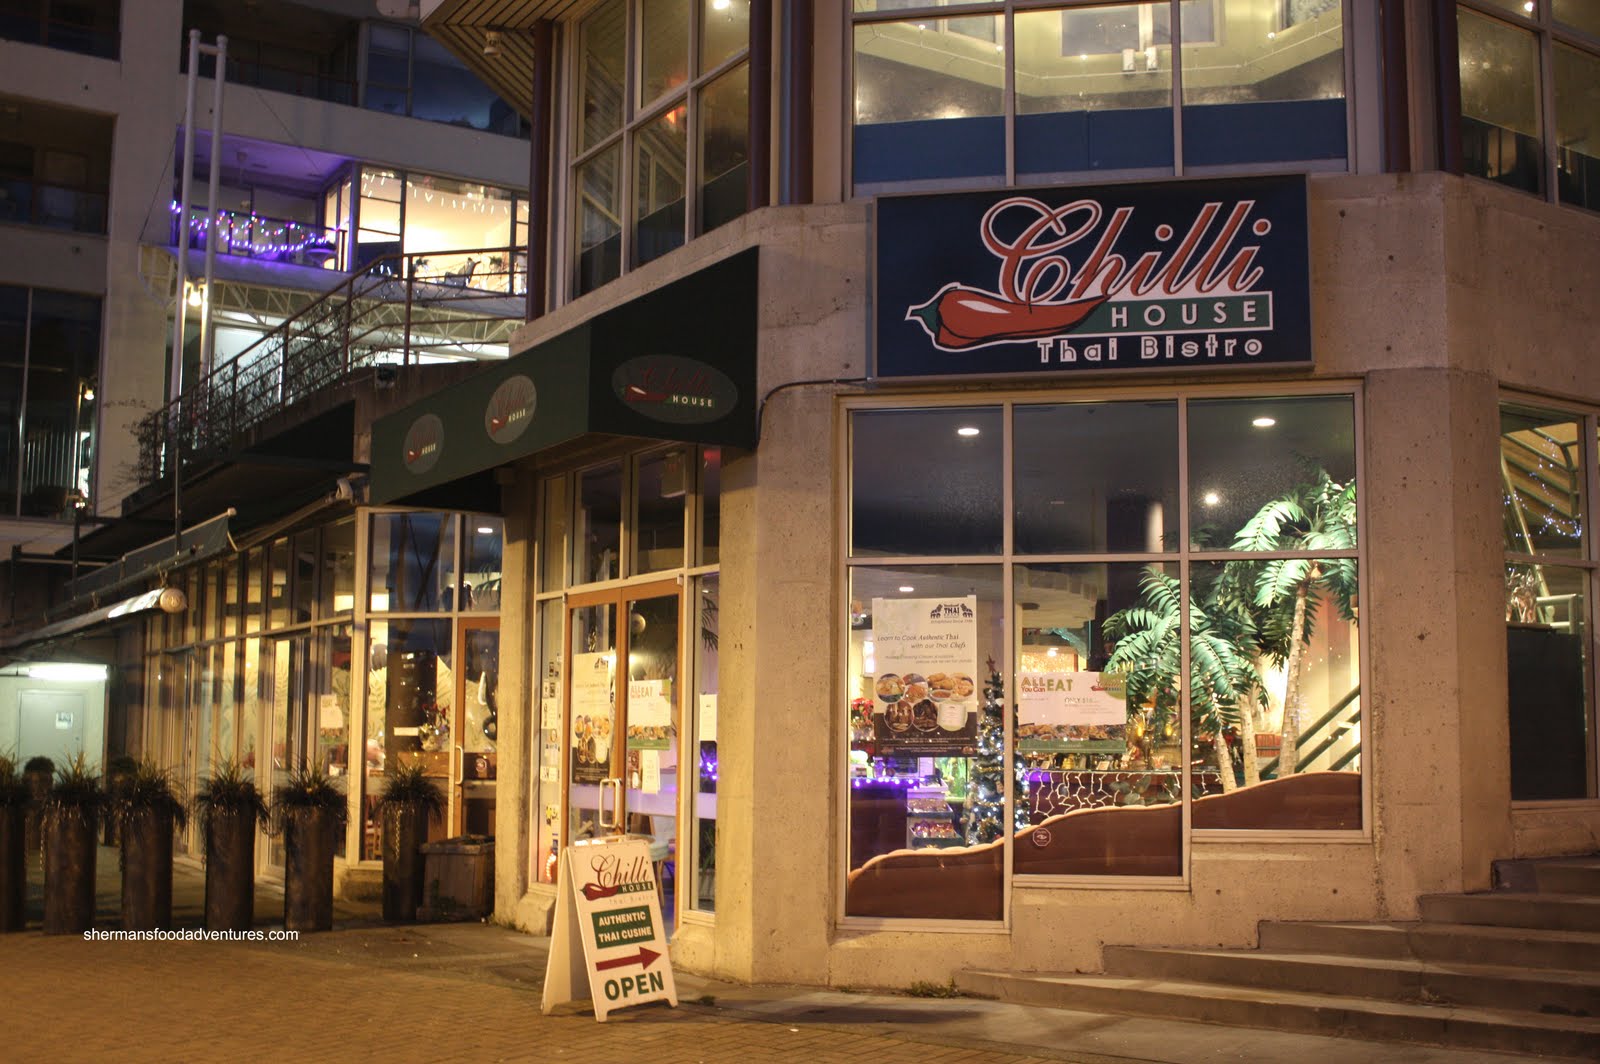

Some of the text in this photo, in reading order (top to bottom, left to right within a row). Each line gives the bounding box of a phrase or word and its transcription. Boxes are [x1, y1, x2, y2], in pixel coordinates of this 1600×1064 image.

[980, 197, 1272, 303] Chilli
[1111, 300, 1256, 328] HOUSE
[1037, 334, 1263, 363] Thai Bistro
[672, 395, 712, 407] HOUSE
[950, 641, 966, 650] Chefs
[1021, 676, 1045, 686] ALL
[1046, 679, 1073, 691] EAT
[591, 854, 649, 887] Chilli
[622, 880, 653, 893] HOUSE
[598, 911, 647, 927] AUTHENTIC
[598, 926, 652, 943] THAI CUSINE
[604, 970, 664, 1001] OPEN
